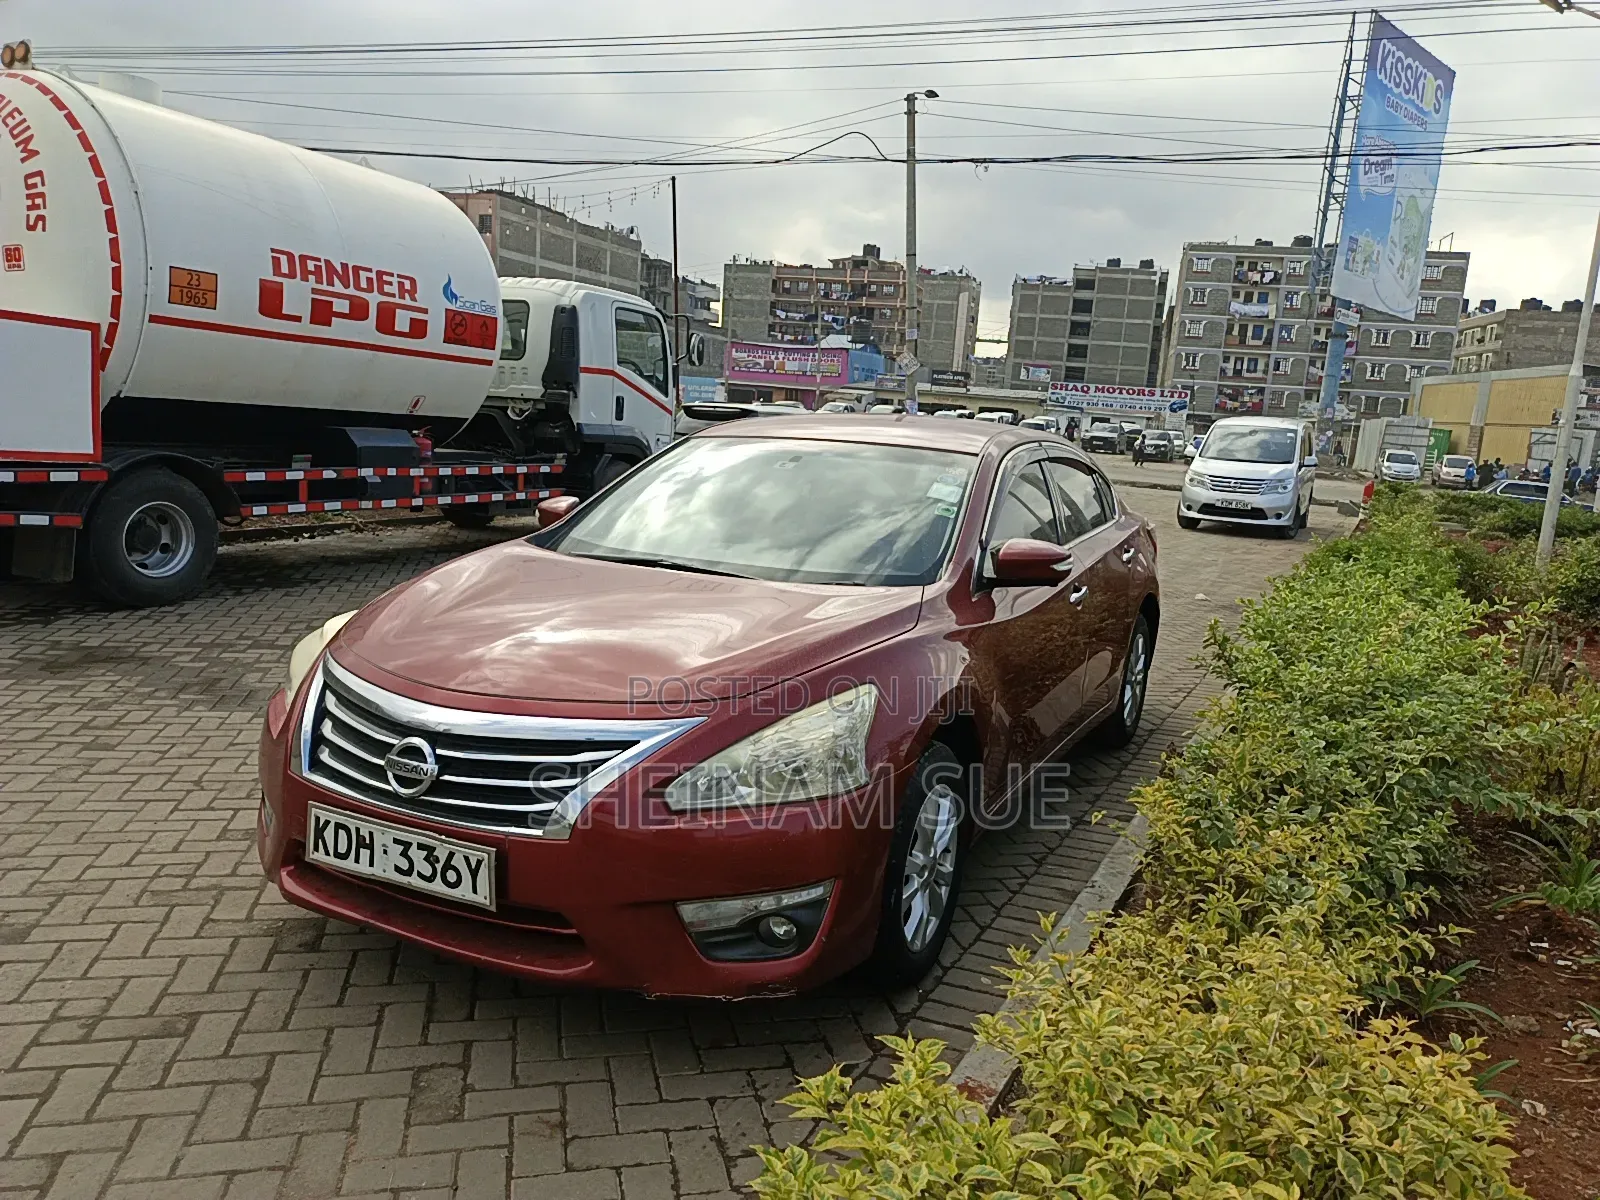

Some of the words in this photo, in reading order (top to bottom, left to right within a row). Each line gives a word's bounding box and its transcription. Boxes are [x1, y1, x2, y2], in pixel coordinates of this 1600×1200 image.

[1386, 96, 1403, 115] BABY
[1404, 107, 1428, 130] DIAPERS
[1364, 157, 1393, 176] Dream
[1379, 172, 1395, 185] Time
[24, 170, 47, 232] GAS
[186, 272, 201, 287] 23
[270, 248, 418, 302] DANGER
[178, 289, 208, 306] 1965
[258, 278, 429, 340] LPG
[1050, 383, 1091, 394] SHAQ
[1094, 385, 1156, 397] MOTORS
[1159, 389, 1189, 399] LTD
[385, 760, 429, 777] NISSAN
[312, 815, 375, 868] KDH
[392, 838, 484, 895] 336Y
